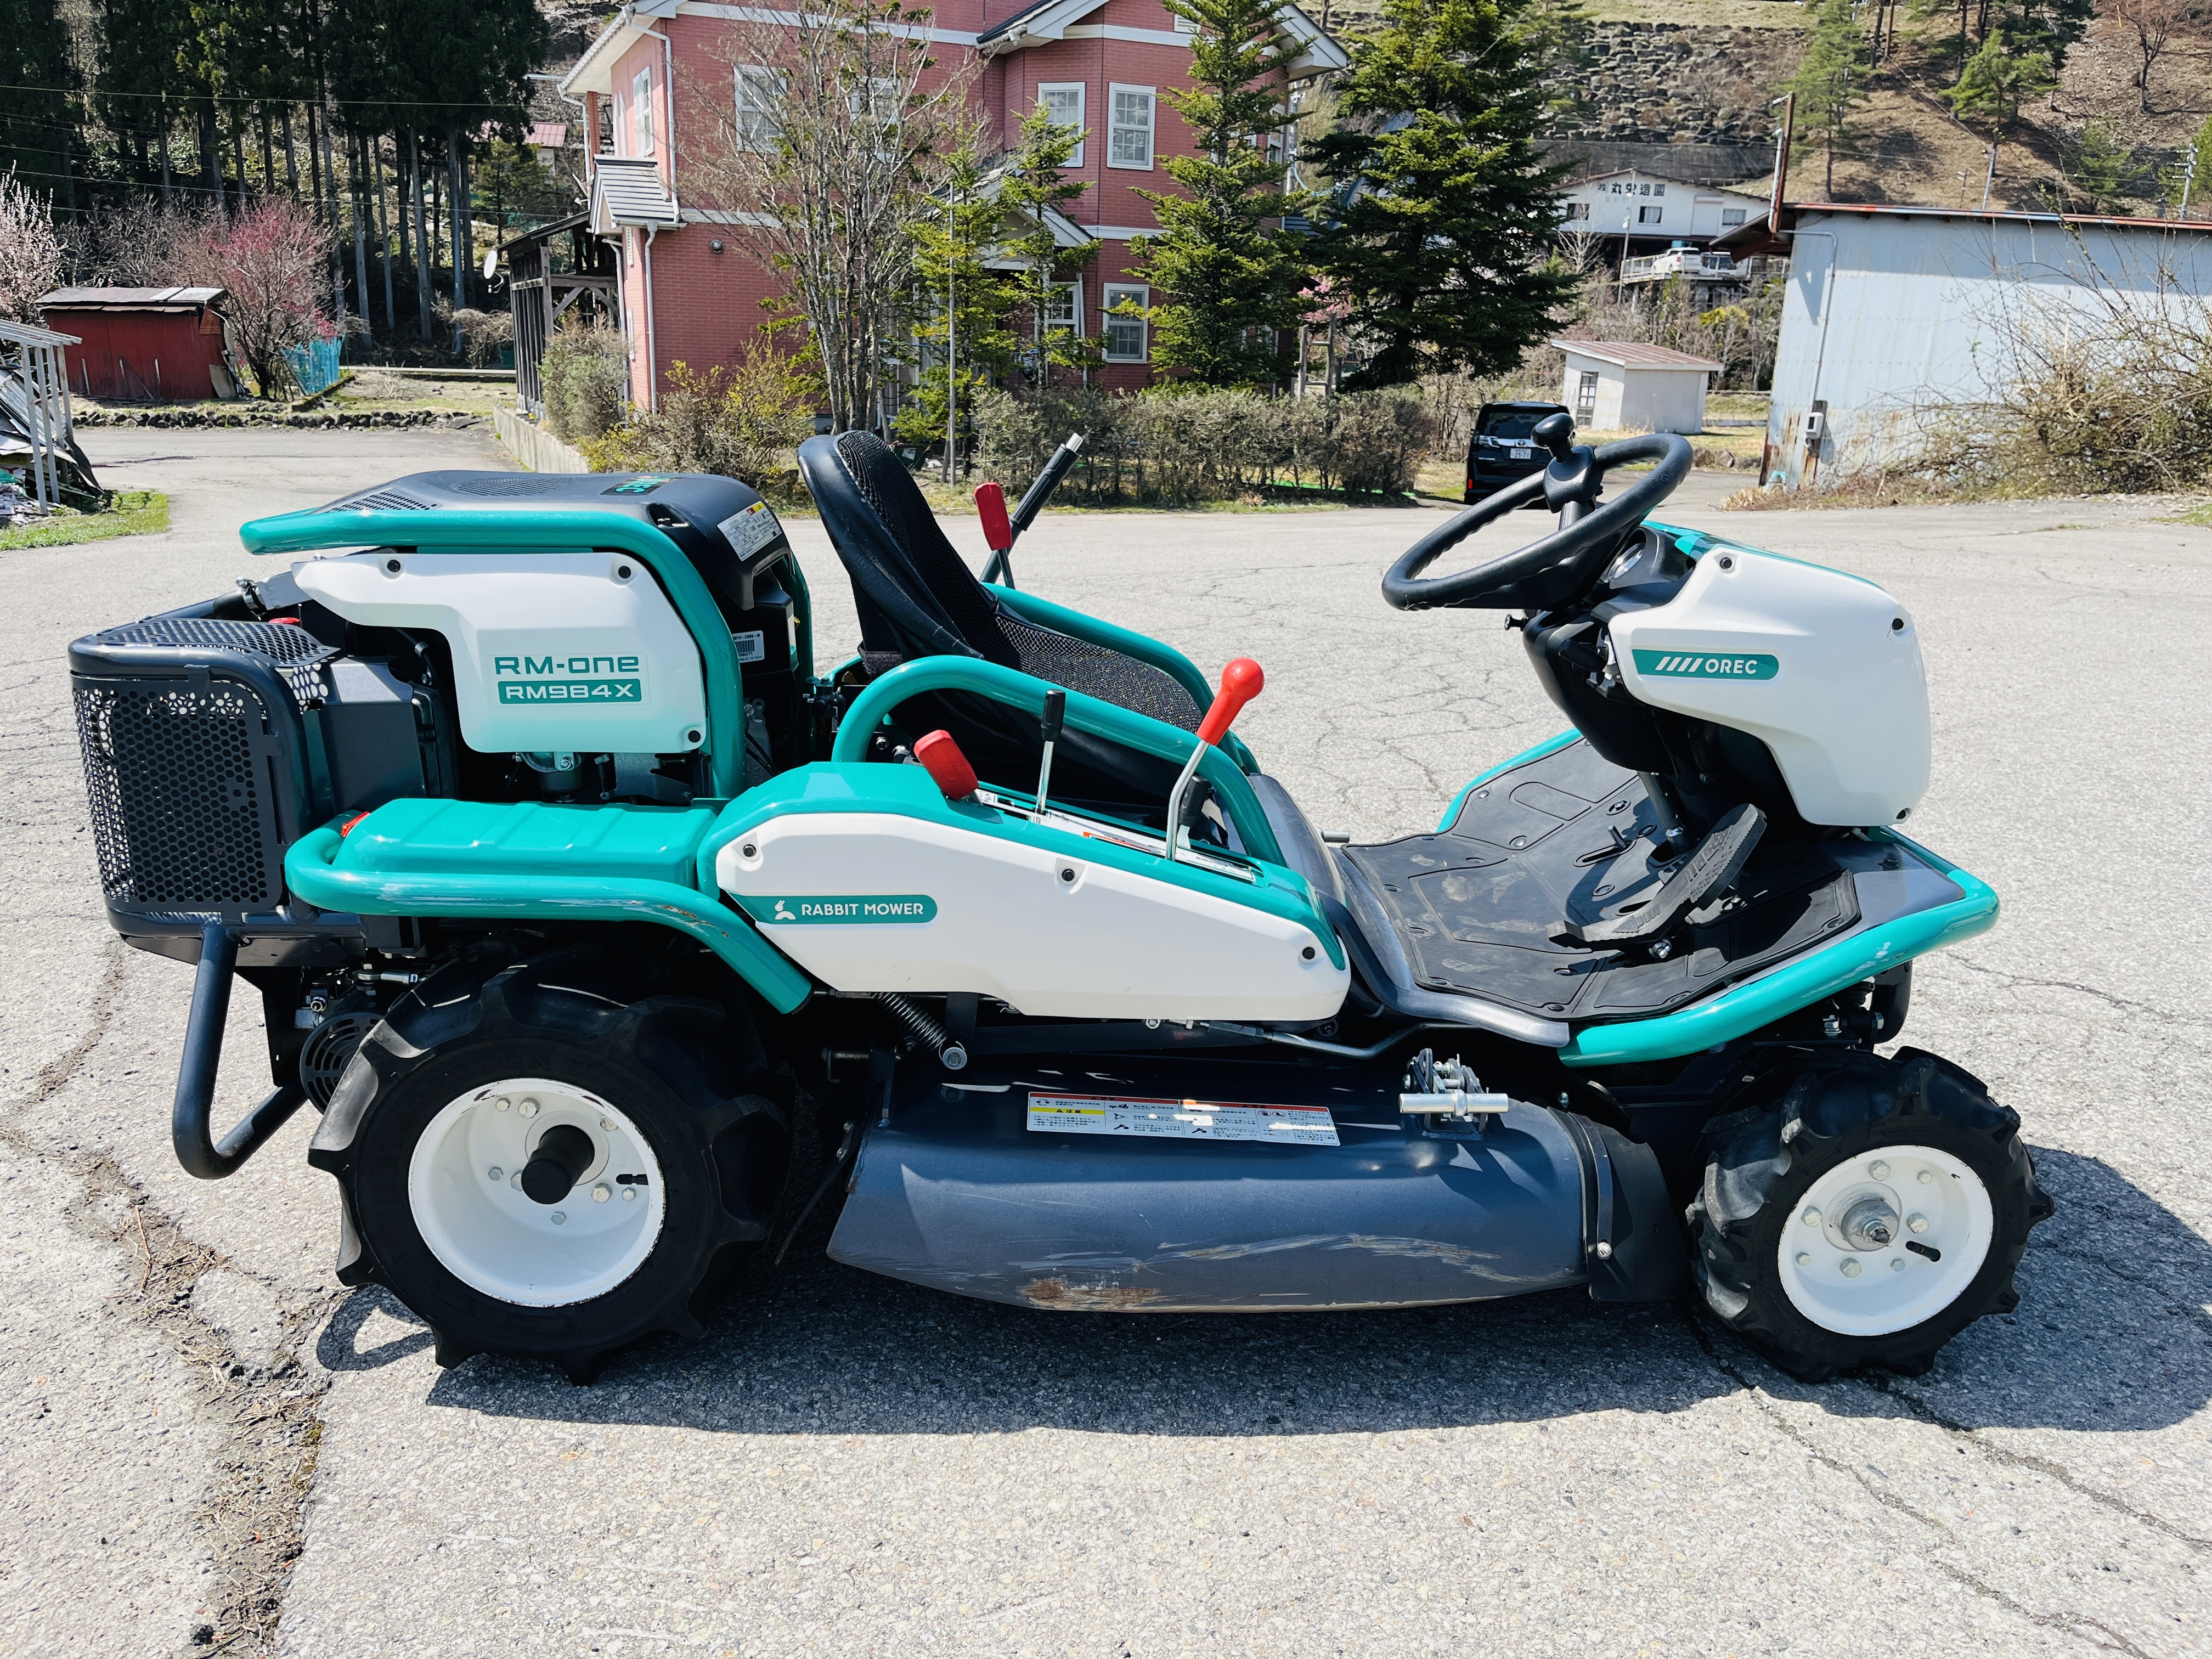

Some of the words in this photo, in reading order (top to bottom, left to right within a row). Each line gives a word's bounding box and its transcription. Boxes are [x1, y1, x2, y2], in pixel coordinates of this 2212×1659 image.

[494, 656, 639, 674] RM-one
[1705, 658, 1758, 674] OREC
[505, 684, 634, 699] RM984X
[802, 904, 859, 916] RABBIT
[864, 903, 924, 915] MOWER
